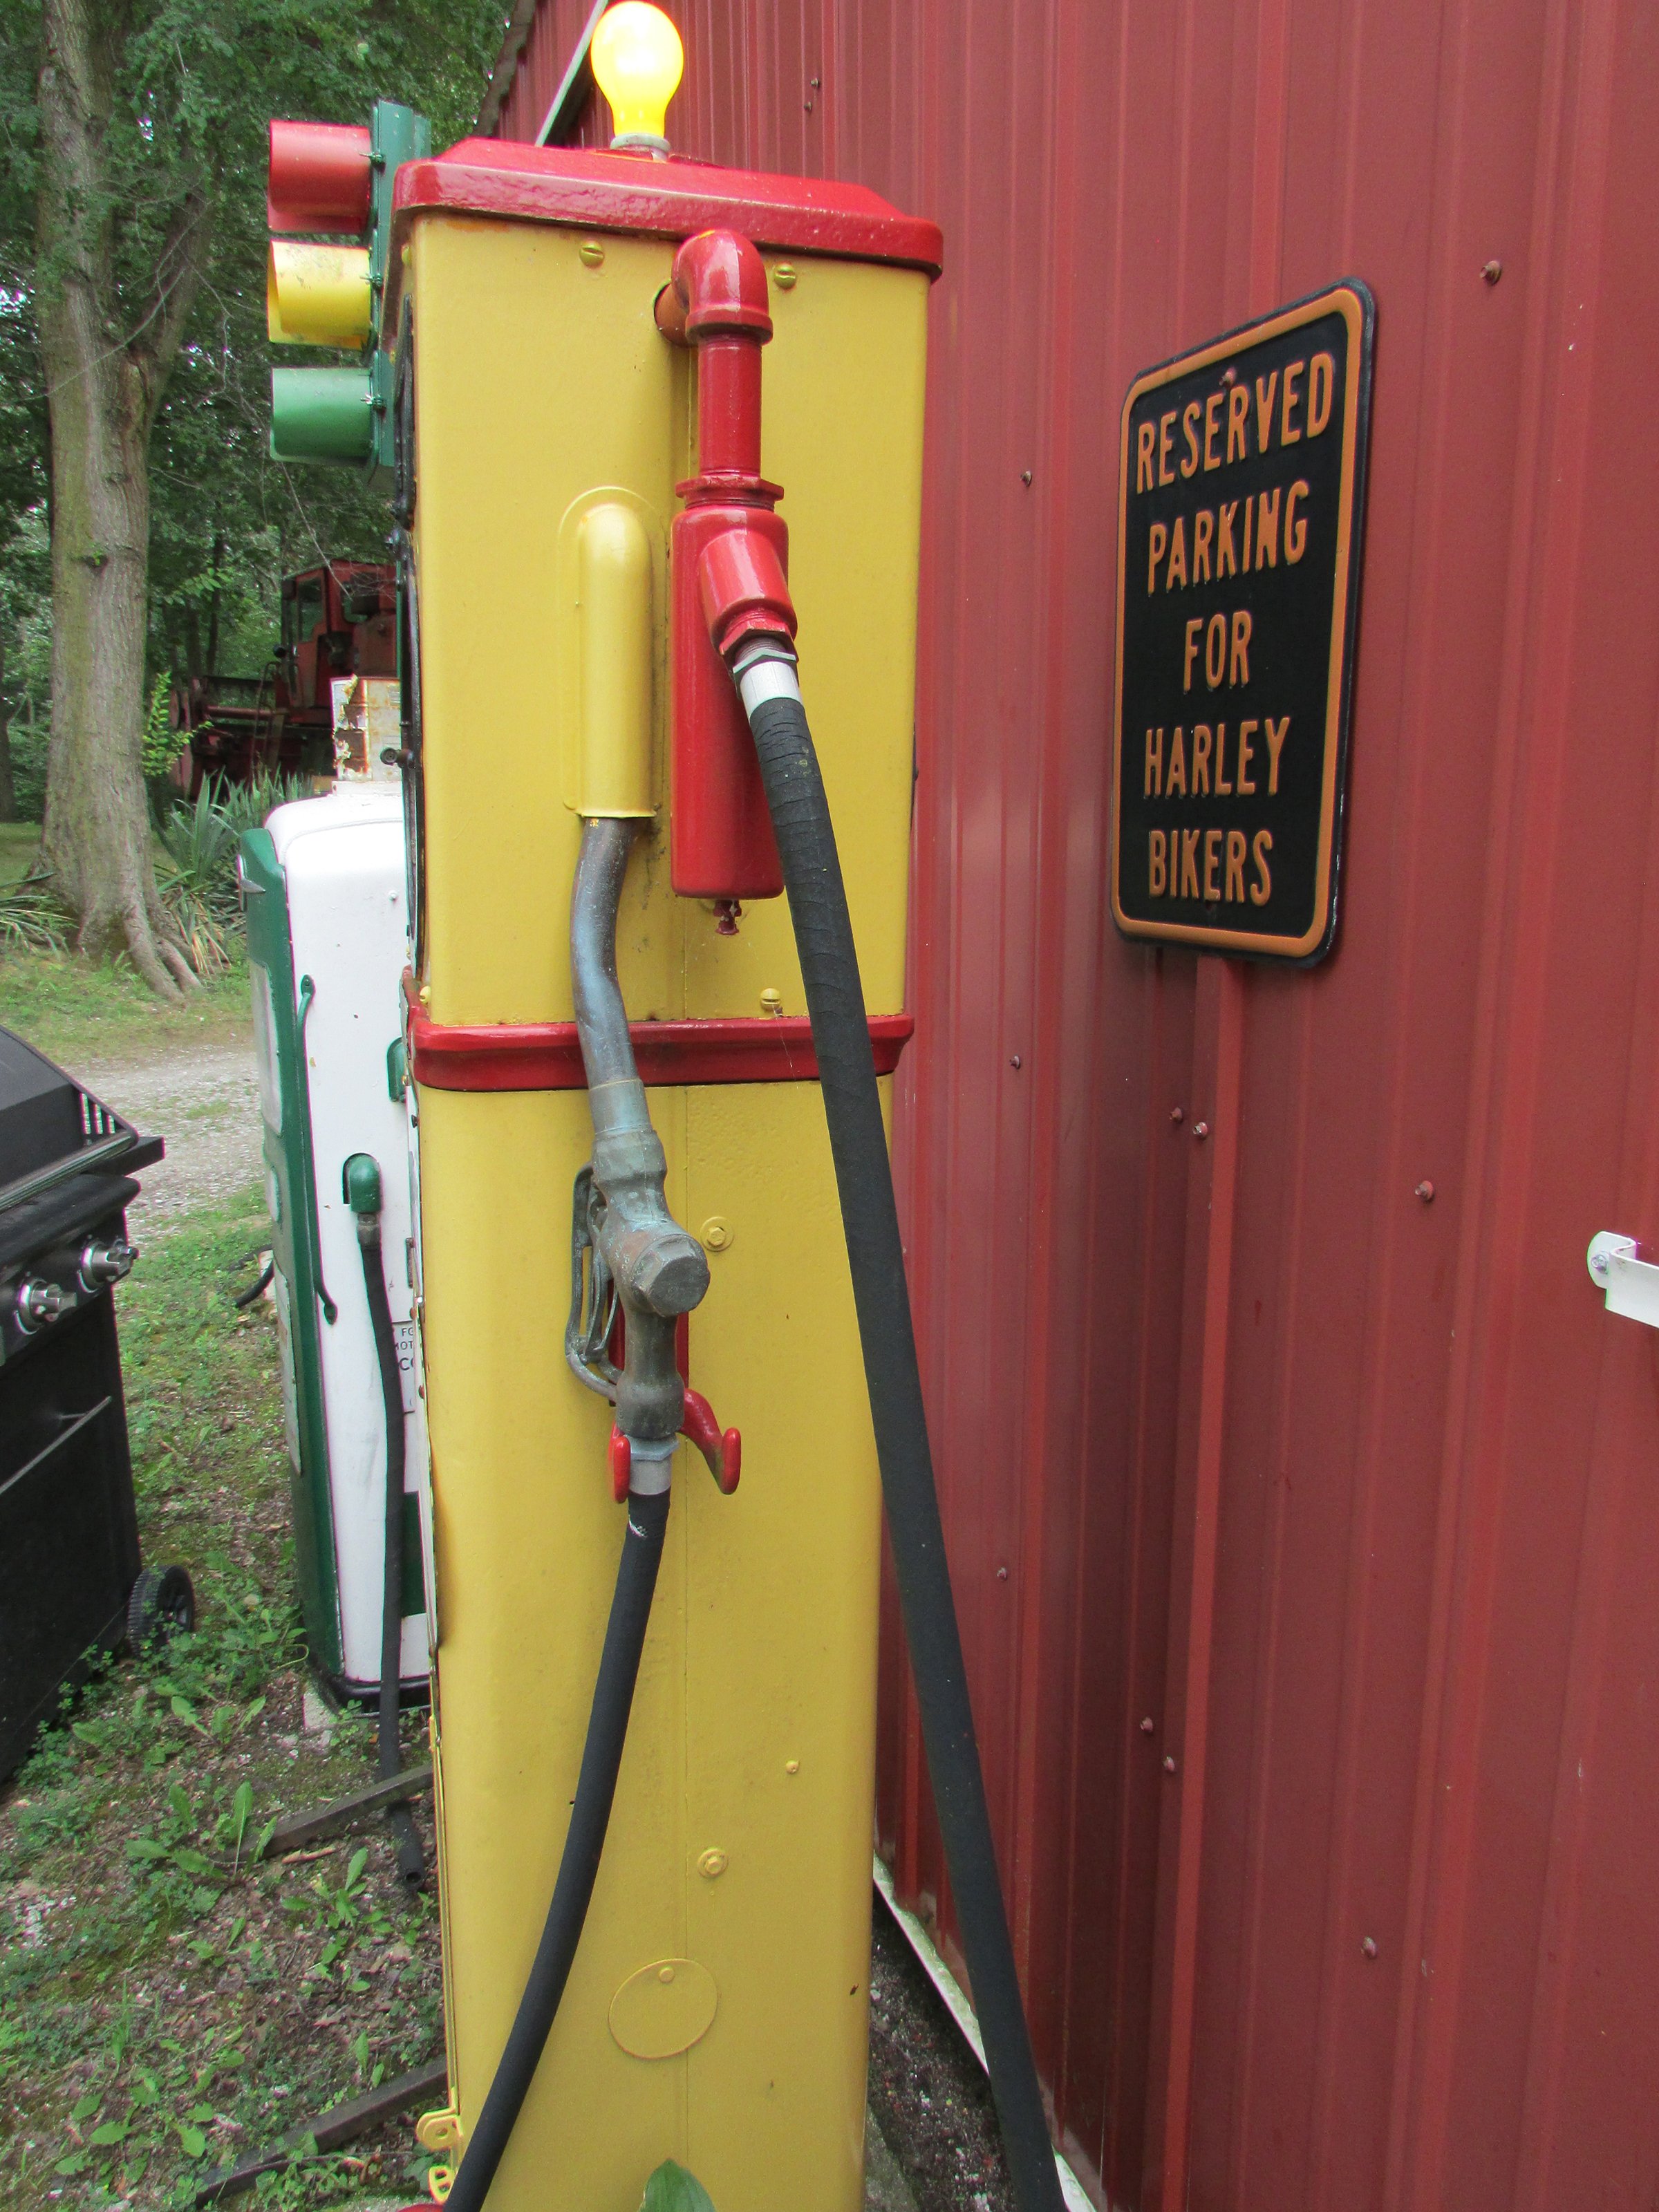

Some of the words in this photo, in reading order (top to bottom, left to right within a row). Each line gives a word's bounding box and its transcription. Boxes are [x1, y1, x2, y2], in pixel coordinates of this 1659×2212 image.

[1136, 351, 1334, 495] RESERVED
[1147, 479, 1309, 594] PARKING
[1183, 610, 1253, 691] FOR
[1145, 716, 1291, 796] HARLEY
[1150, 828, 1273, 907] BIKERS
